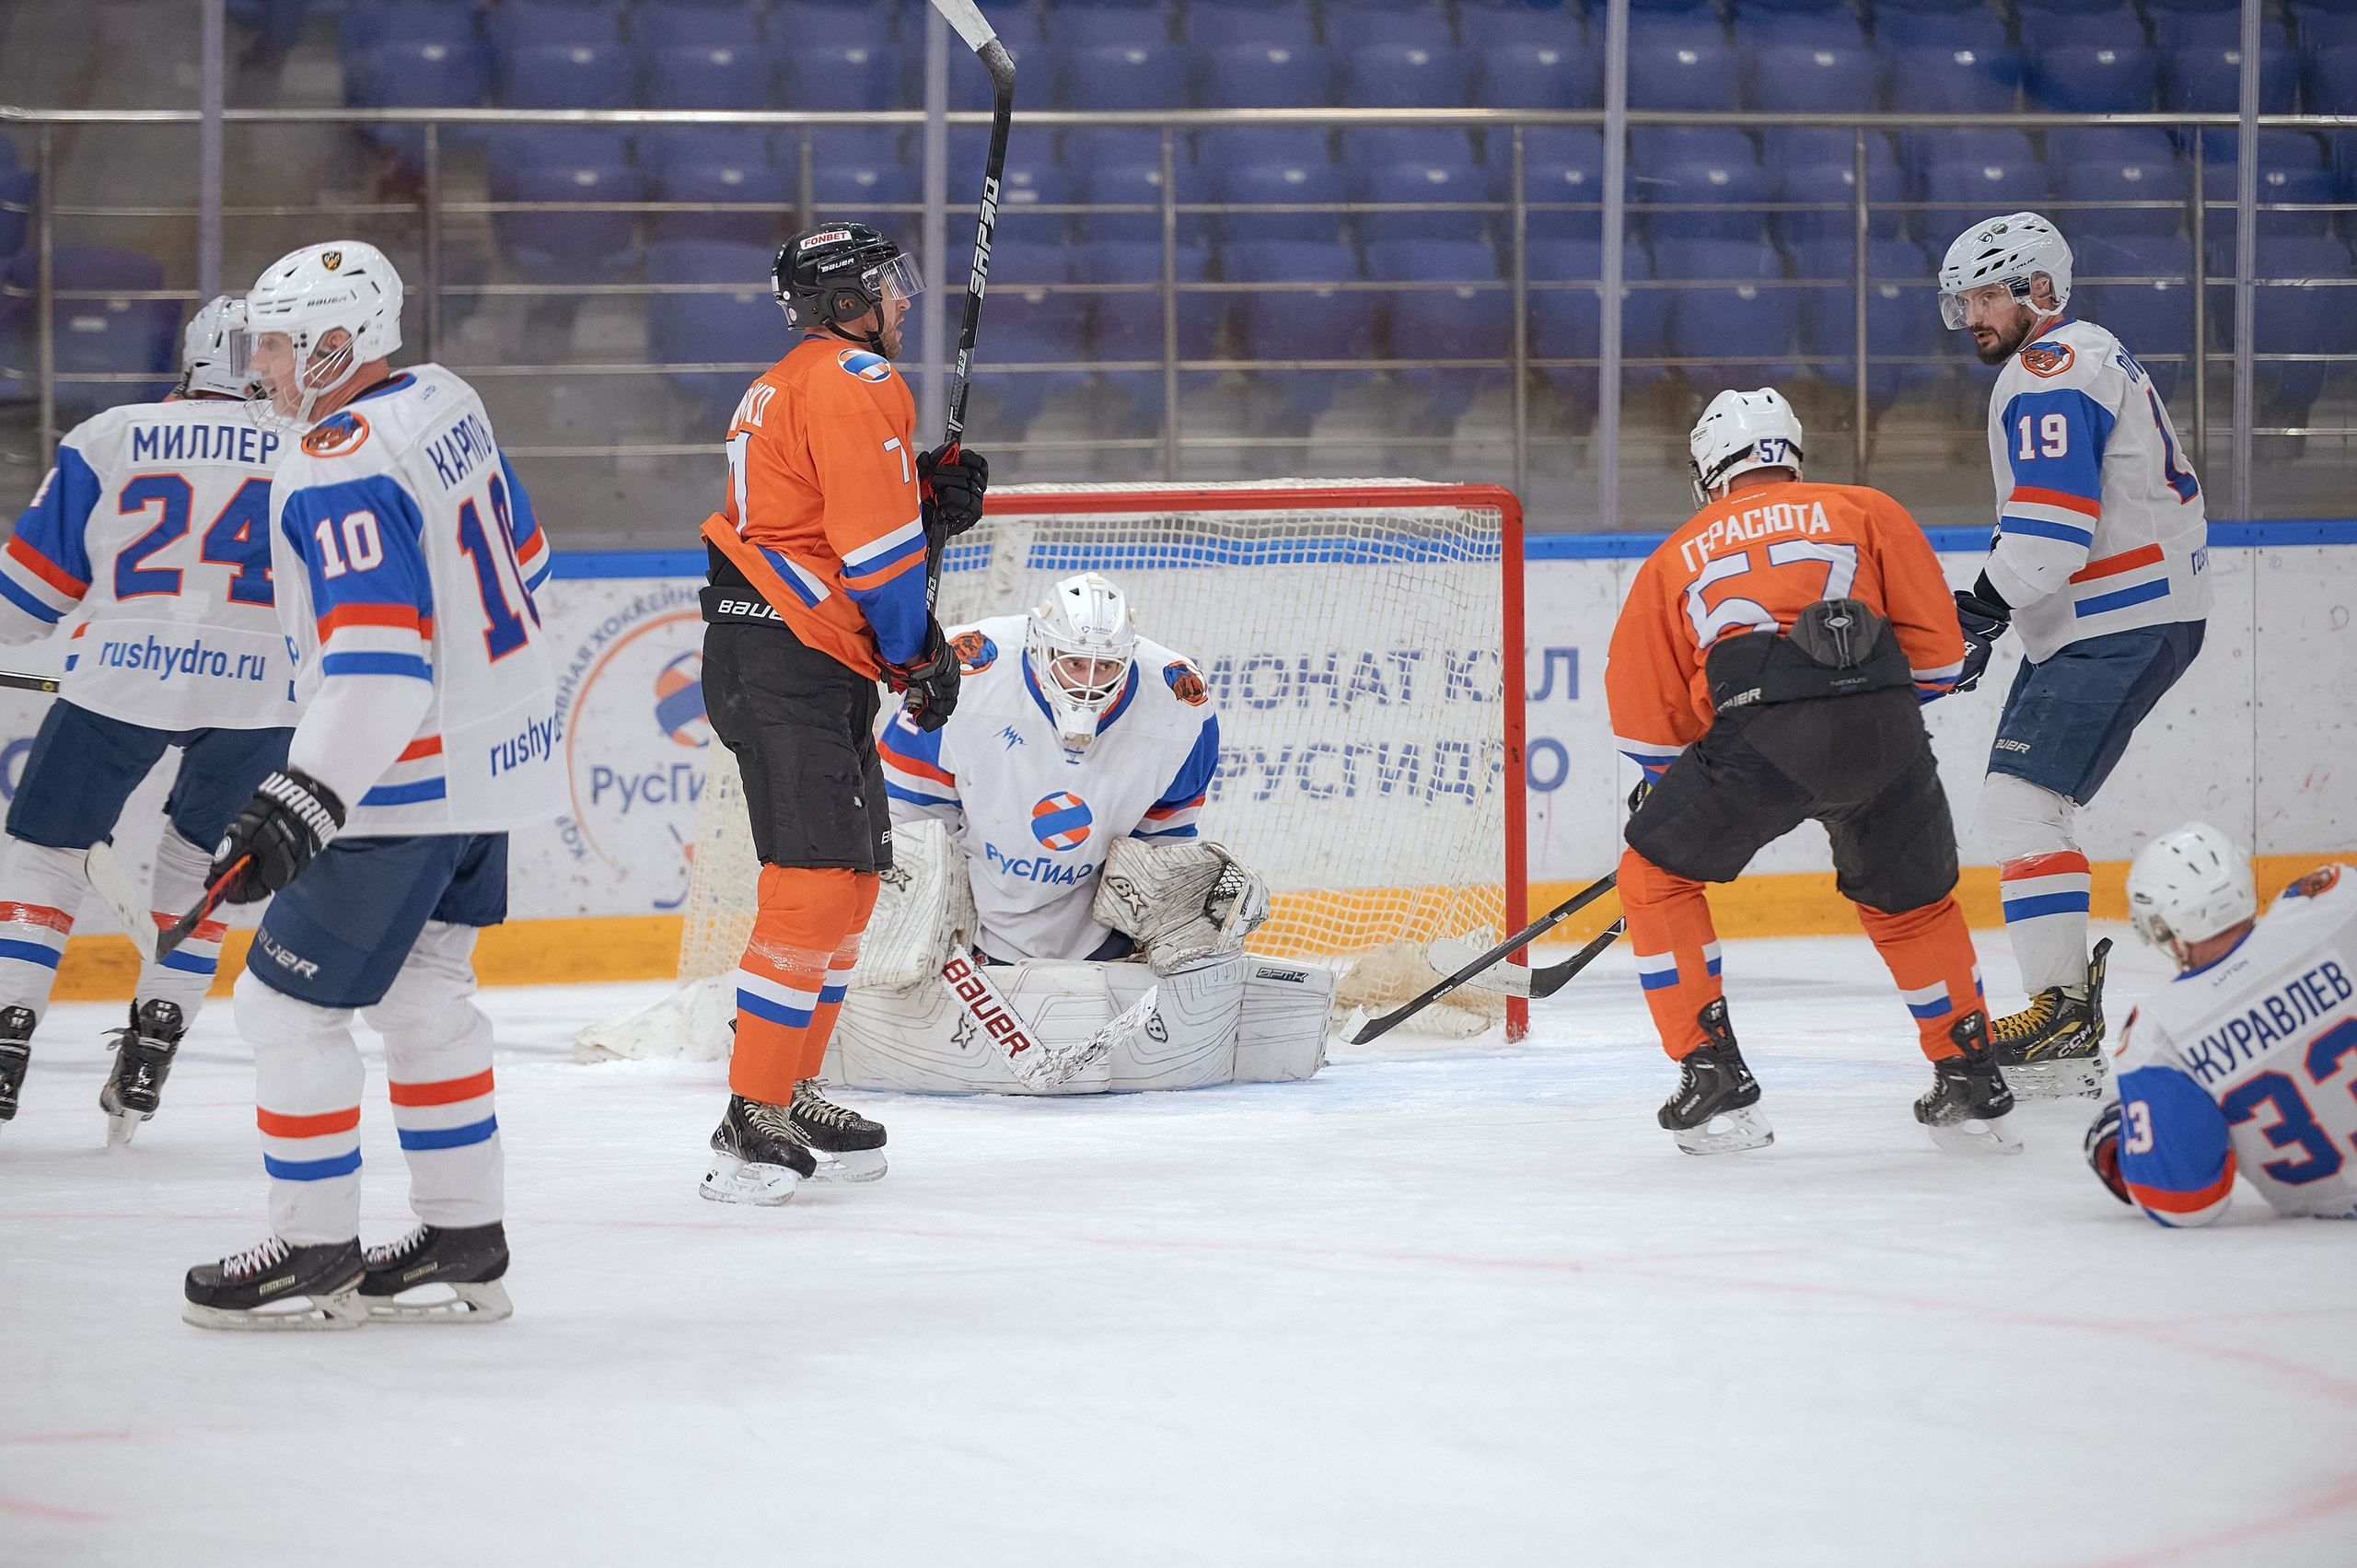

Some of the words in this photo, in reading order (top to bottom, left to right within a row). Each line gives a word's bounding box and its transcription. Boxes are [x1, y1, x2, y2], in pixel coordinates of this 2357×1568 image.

[804, 231, 847, 248] FONBET
[820, 258, 854, 273] BAUER
[2010, 257, 2036, 271] TRUE
[133, 424, 280, 464] МИЛЛЕР
[882, 436, 910, 484] 7
[1759, 437, 1787, 463] 57
[2018, 412, 2068, 460] 19
[113, 472, 275, 608] 24
[315, 510, 383, 580] 10
[1680, 501, 1831, 573] ГЕРАСЮТА
[717, 598, 784, 621] BAUE
[1682, 538, 1858, 650] 57
[99, 635, 266, 681] rushydro.ru
[1717, 688, 1761, 713] AUER
[591, 762, 707, 814] РусГи
[1213, 737, 1570, 806] РУСГИДРО
[258, 771, 339, 853] WARRIO
[985, 842, 1094, 886] РусГидр
[257, 925, 319, 981] AUER
[941, 957, 1030, 1059] BAUER
[2178, 960, 2353, 1085] ЖУРАВЛЕВ
[2058, 1024, 2093, 1058] CCM
[789, 1120, 812, 1140] CCM
